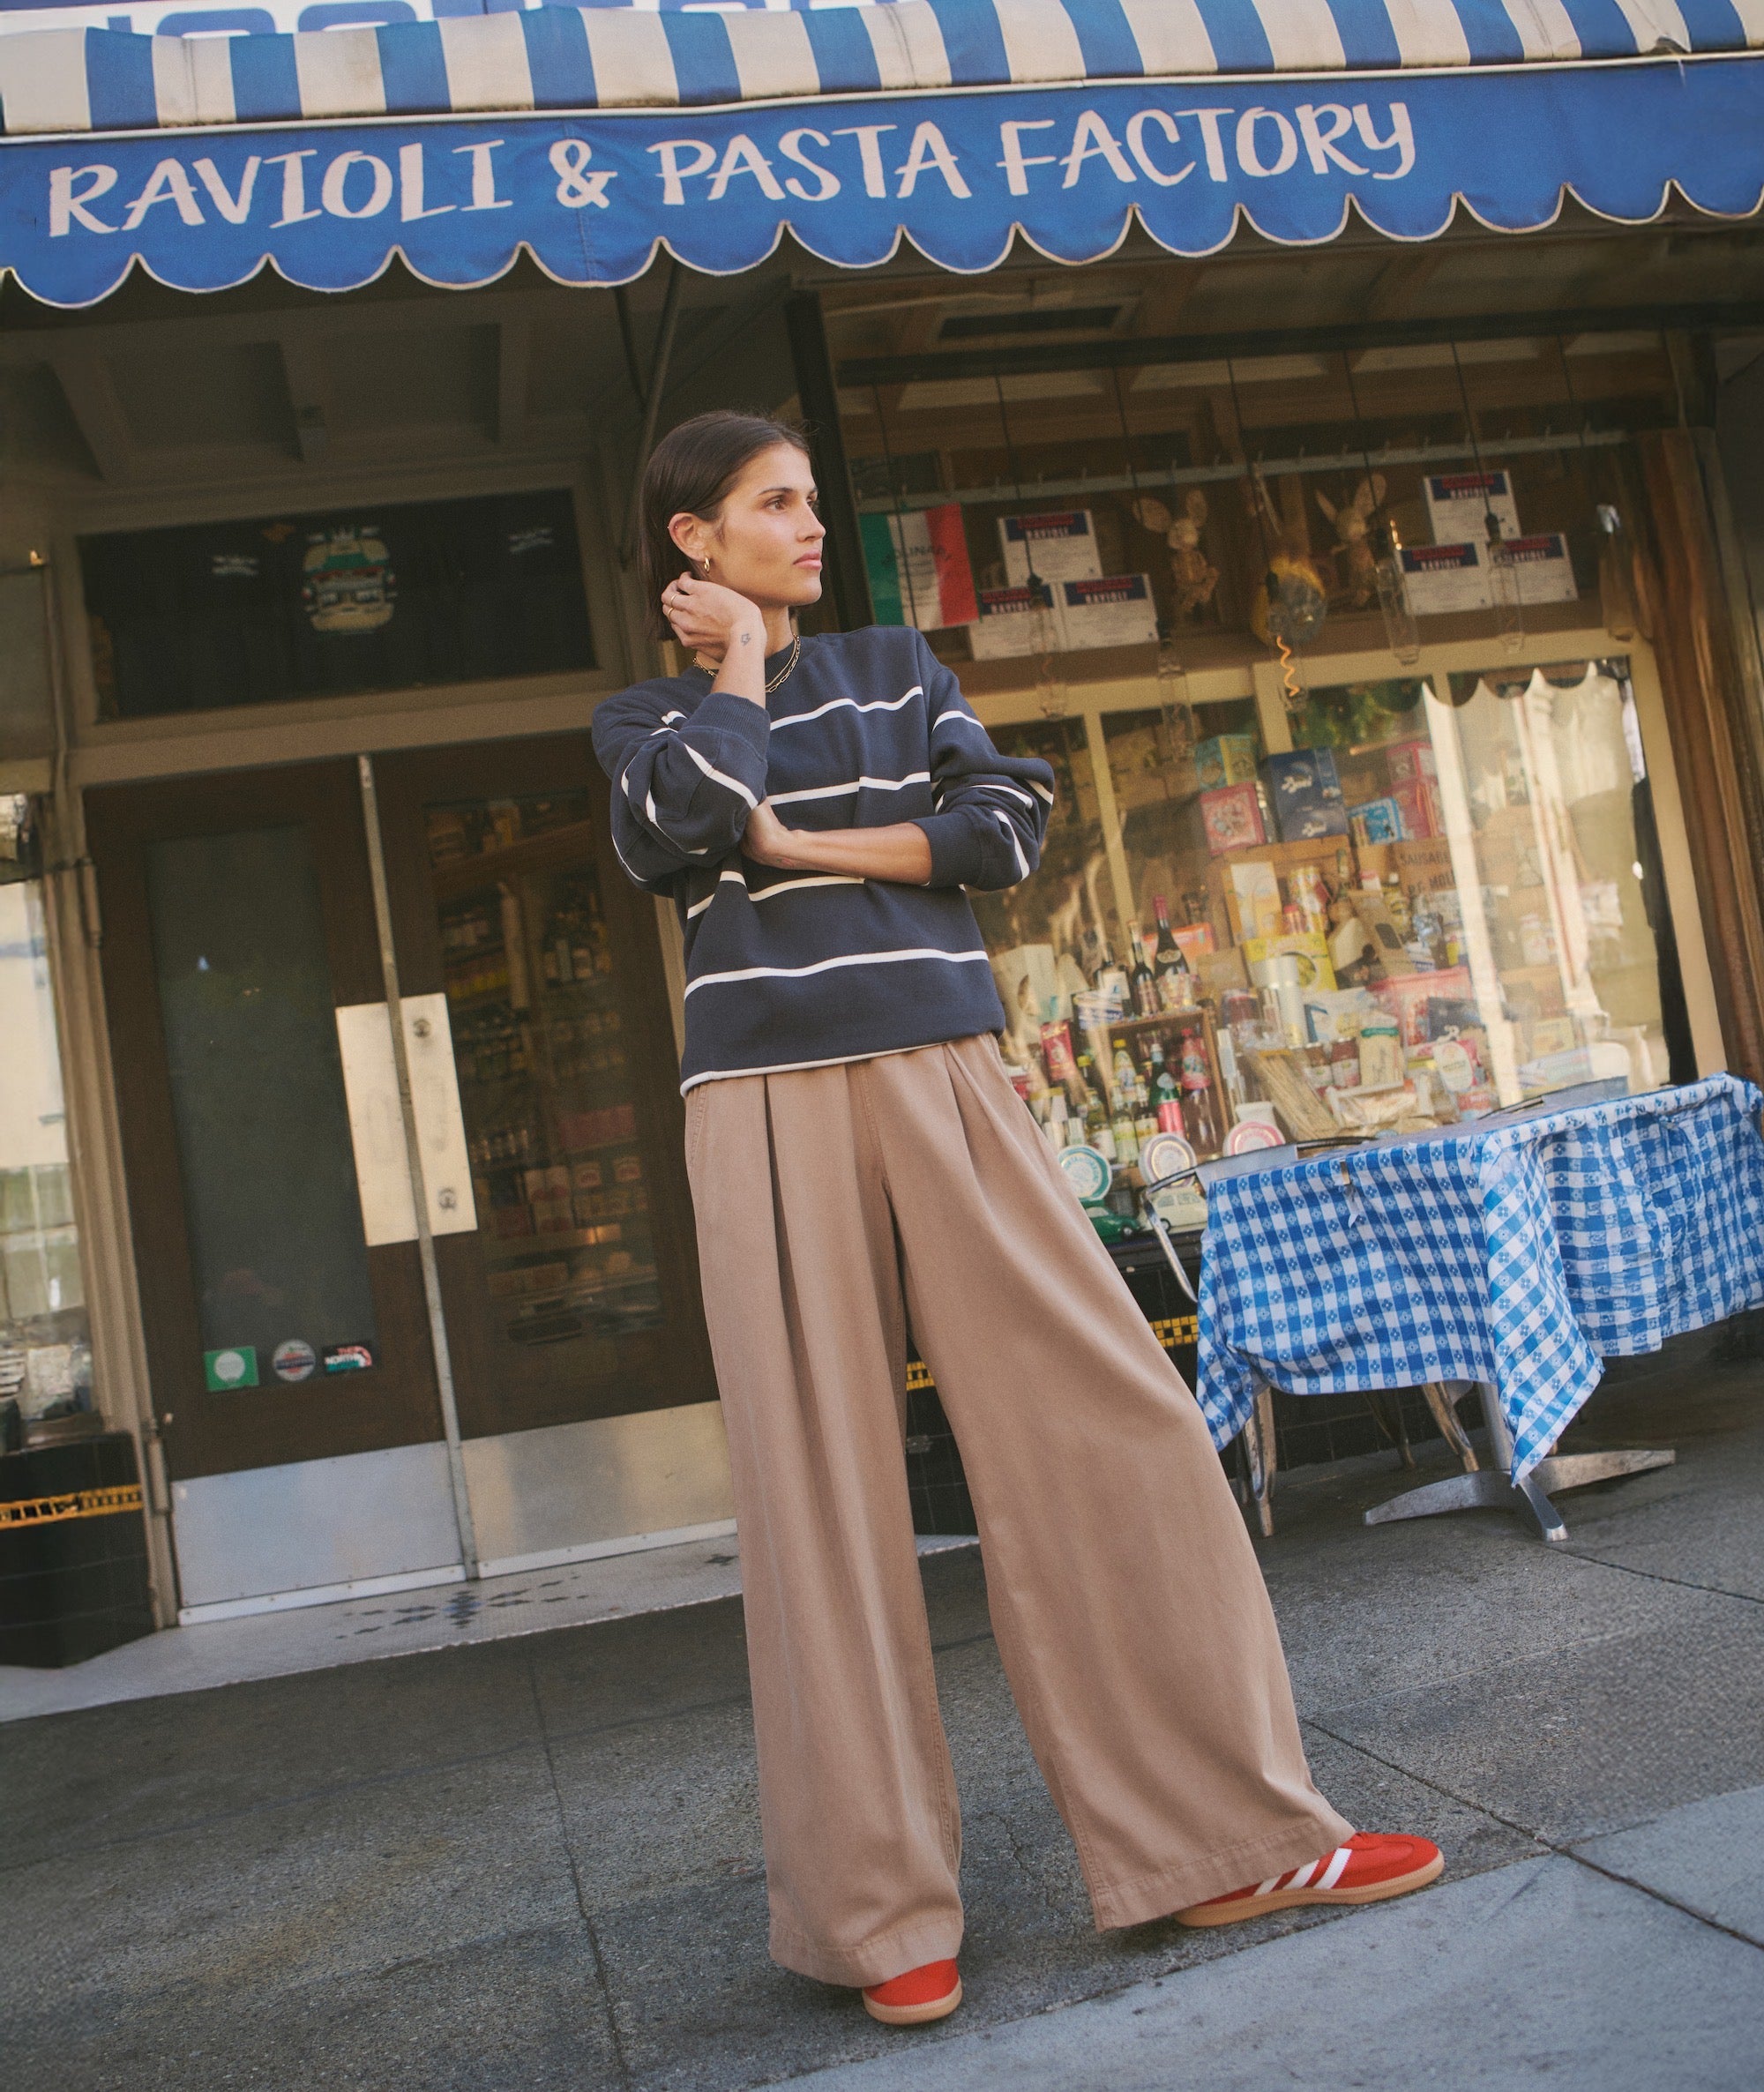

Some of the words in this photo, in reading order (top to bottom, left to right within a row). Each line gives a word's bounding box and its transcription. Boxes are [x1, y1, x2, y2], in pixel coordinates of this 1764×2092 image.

[49, 138, 513, 238] RAVIOLI
[548, 138, 618, 209] &
[645, 120, 973, 205] PASTA
[995, 101, 1416, 197] FACTORY
[1025, 526, 1070, 540] RAVIOLI
[1084, 590, 1130, 605] RAVIOLI
